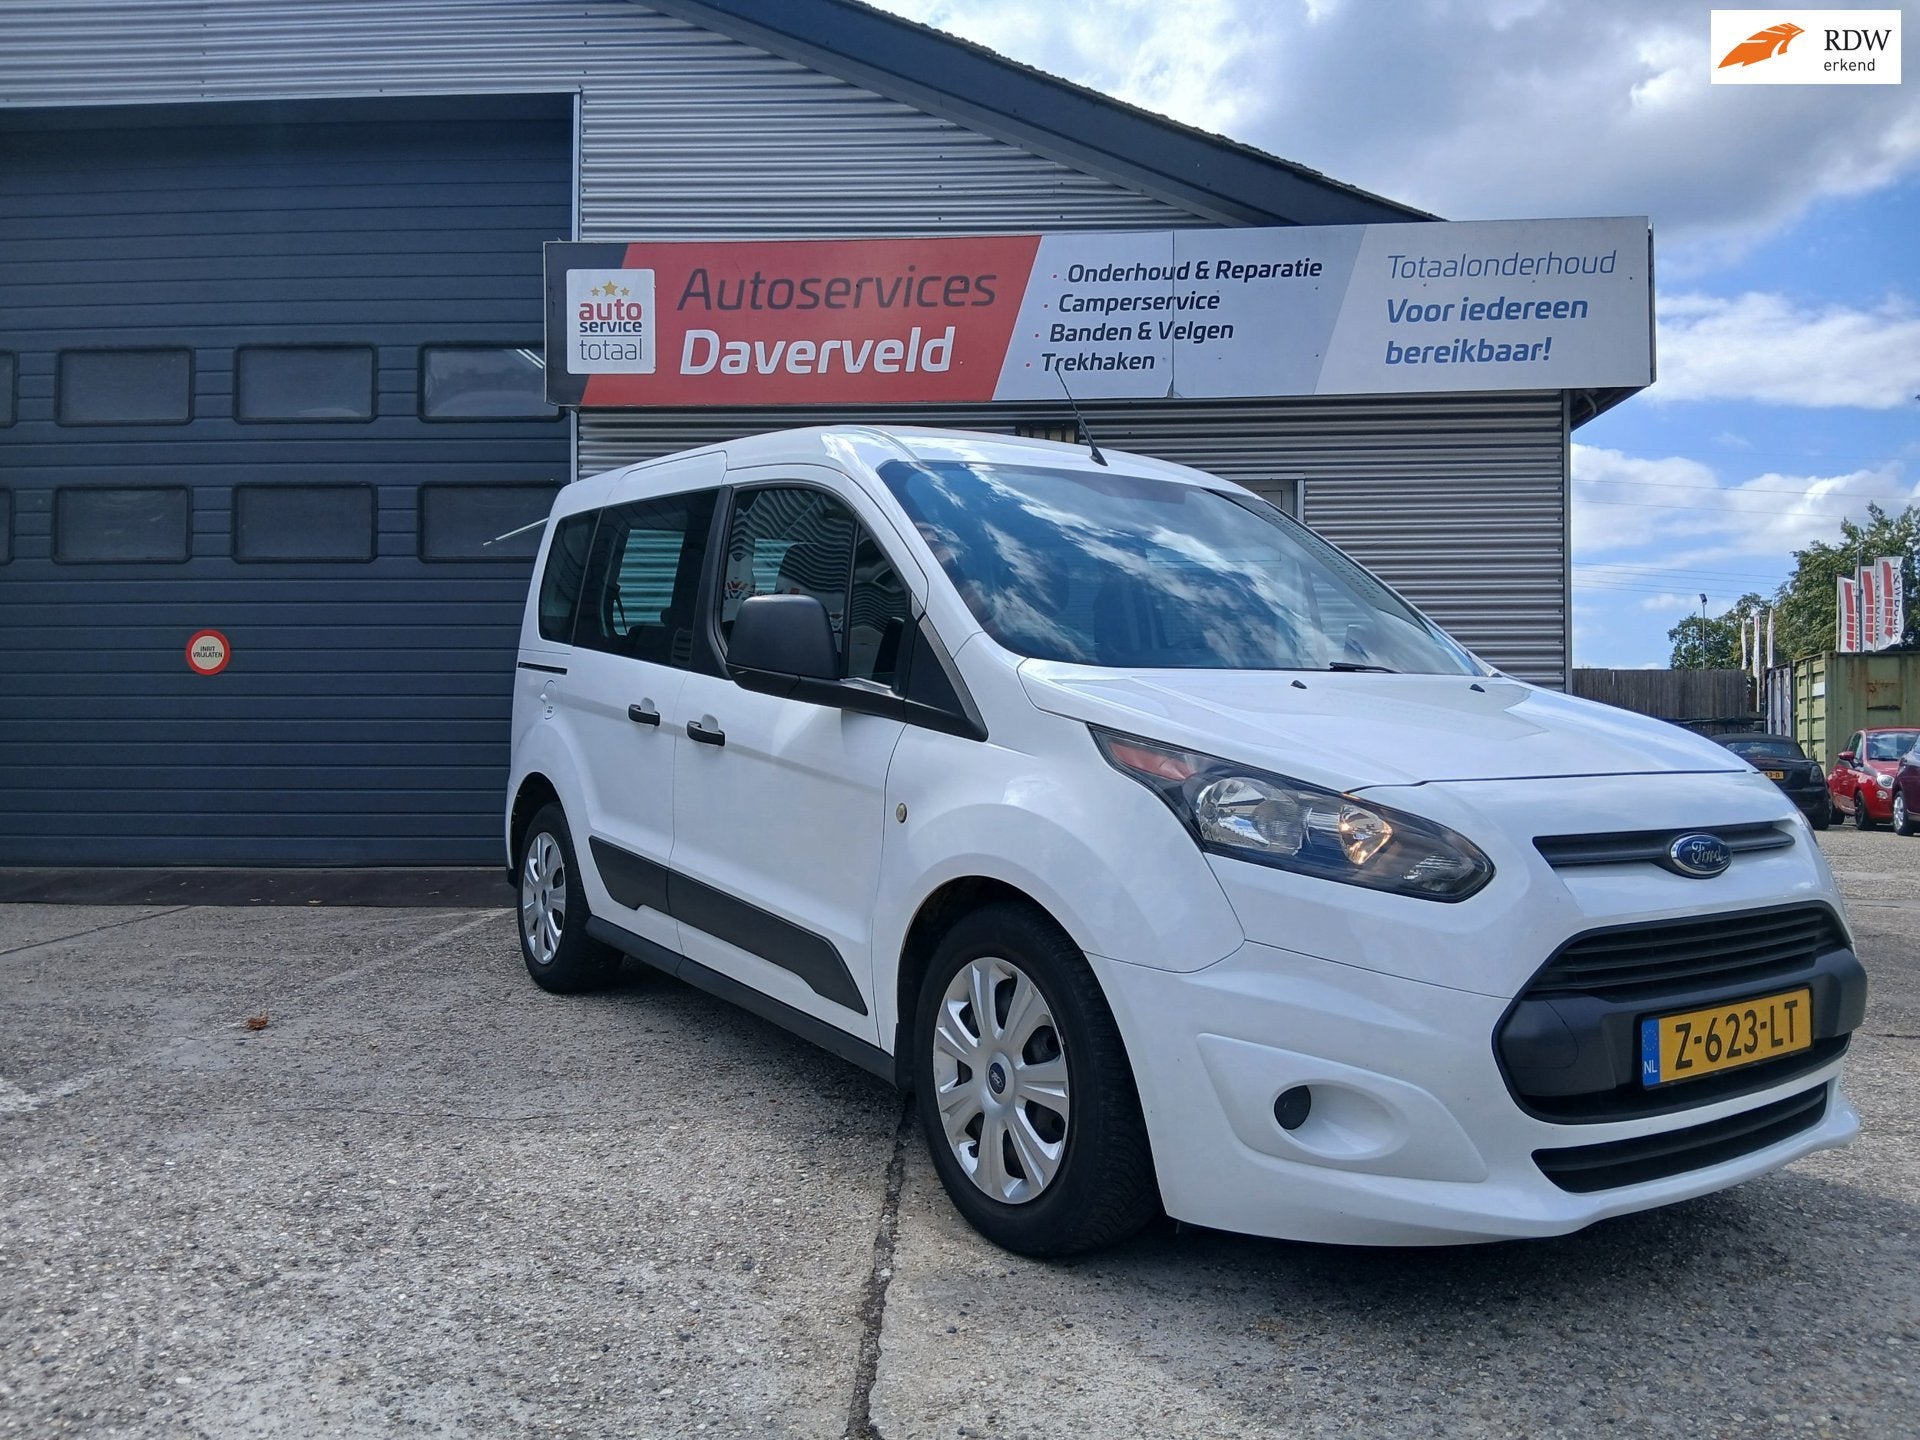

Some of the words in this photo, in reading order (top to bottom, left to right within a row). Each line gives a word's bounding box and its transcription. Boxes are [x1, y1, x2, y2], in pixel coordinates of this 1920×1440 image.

[1067, 261, 1189, 283] Onderhoud
[1195, 260, 1210, 280] &
[1215, 258, 1323, 283] Reparatie
[1387, 250, 1617, 279] Totaalonderhoud
[677, 264, 998, 312] Autoservices
[579, 298, 642, 321] auto
[1058, 290, 1220, 316] Camperservice
[1386, 298, 1455, 323] Voor
[1460, 297, 1588, 321] iedereen
[579, 321, 643, 333] service
[1049, 322, 1132, 343] Banden
[1137, 321, 1152, 341] &
[1158, 320, 1234, 345] Velgen
[579, 338, 642, 361] totaal
[679, 326, 956, 375] Daverveld
[1041, 352, 1155, 372] Trekhaken
[1385, 336, 1552, 365] bereikbaar!
[1691, 840, 1729, 865] Ford
[1675, 1000, 1798, 1071] Z-623-LT
[1643, 1060, 1658, 1075] NL
